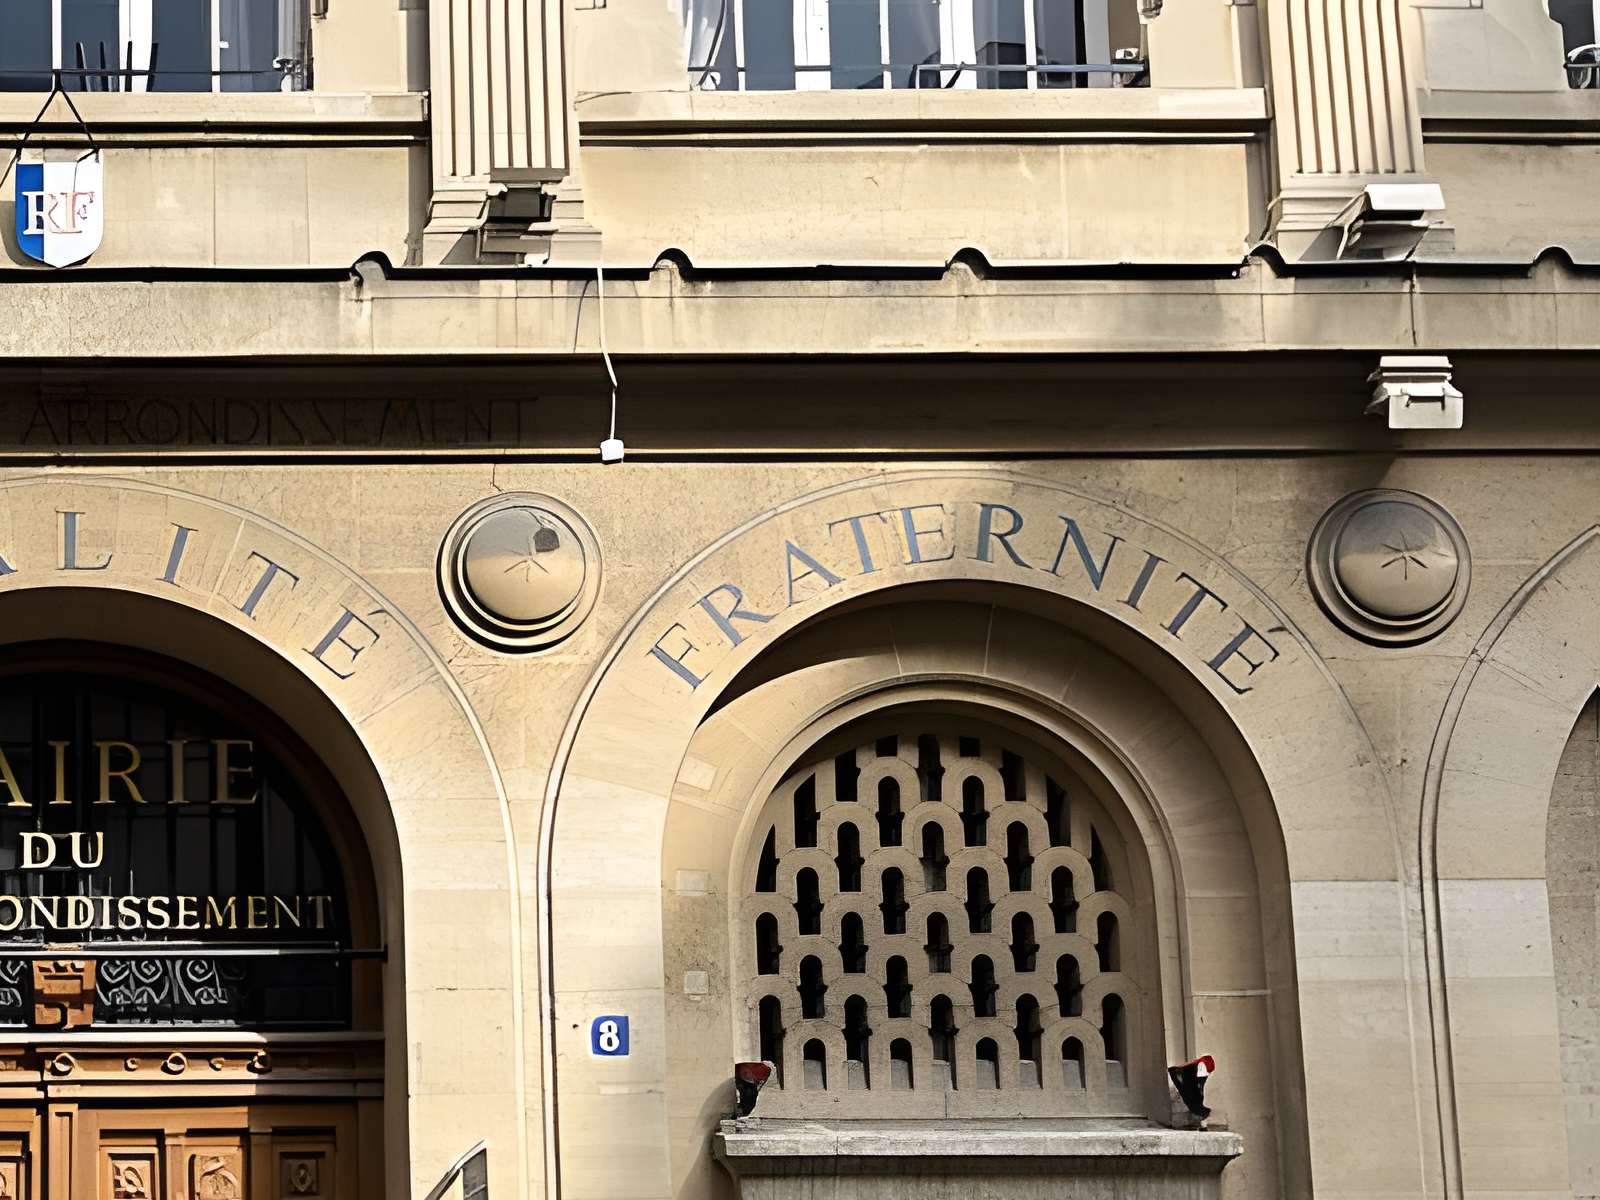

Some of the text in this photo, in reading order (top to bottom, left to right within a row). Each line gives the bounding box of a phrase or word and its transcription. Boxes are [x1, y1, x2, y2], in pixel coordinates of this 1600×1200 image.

[22, 191, 95, 235] RF
[646, 502, 1284, 695] FRATERNITÉ
[18, 831, 106, 870] DU
[599, 1019, 620, 1052] 8
